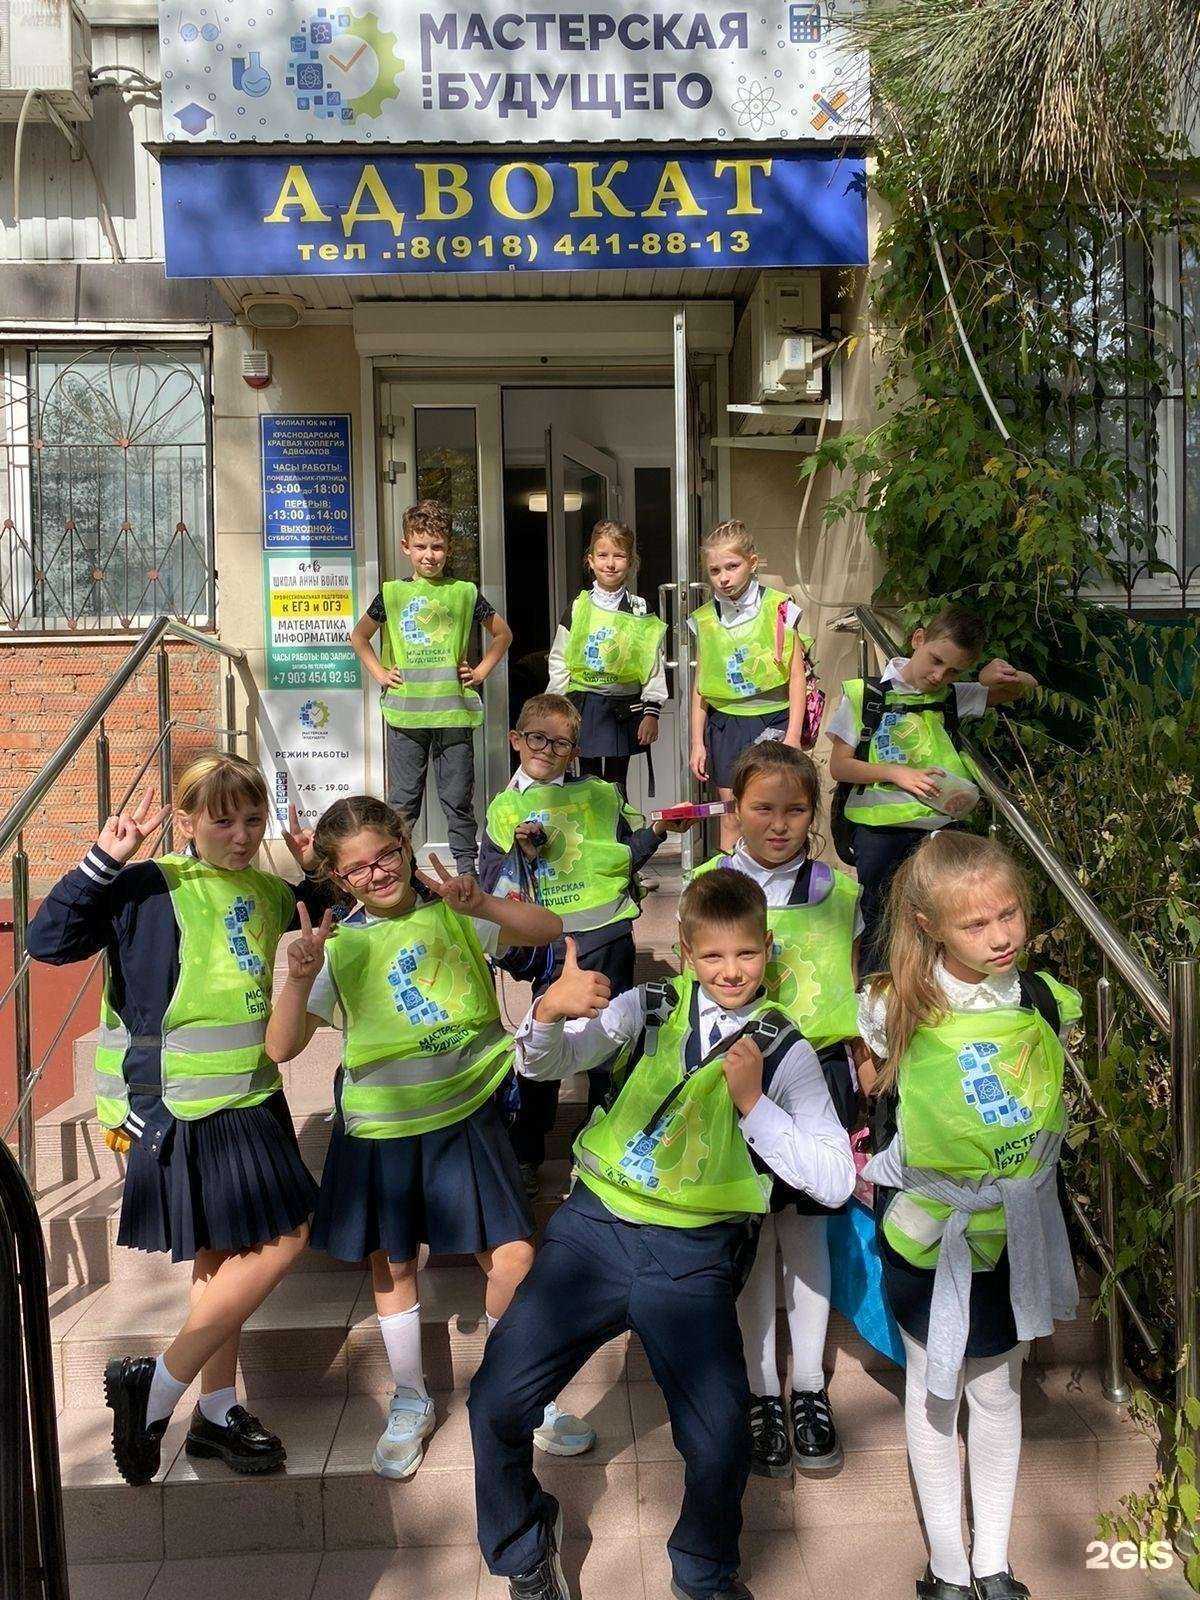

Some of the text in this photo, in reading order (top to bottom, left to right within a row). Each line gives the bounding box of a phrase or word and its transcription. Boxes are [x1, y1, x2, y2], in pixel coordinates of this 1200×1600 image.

[420, 12, 749, 73] МАСТЕРСКАЯ
[438, 73, 713, 118] БУДУЩЕГО
[263, 157, 773, 237] АДВОКАТ
[297, 243, 366, 261] тел
[553, 230, 751, 255] 441-88-13
[272, 431, 340, 439] КРАСНОДАРСКАЯ
[282, 448, 330, 456] АДВОКАТОВ
[272, 463, 343, 472] ЧАСЫ РАБОТЫ:
[314, 483, 345, 494] 18:00
[273, 509, 305, 520] 13:00
[317, 509, 348, 520] 14:00
[292, 601, 310, 612] ЕГЭ
[322, 600, 341, 612] ОГЭ
[278, 619, 347, 631] МАТЕМАТИКА
[274, 632, 352, 643] ИНФОРМАТИКА
[272, 652, 356, 662] ЧАСЫ РАБОТЫ: ПО ЗАПИСИ
[273, 672, 286, 684] +7
[287, 672, 307, 684] 903
[308, 671, 327, 684] 454
[329, 670, 342, 683] 92
[275, 750, 349, 759] РЕЖИМ РАБОТЫ
[297, 809, 318, 817] 9.00
